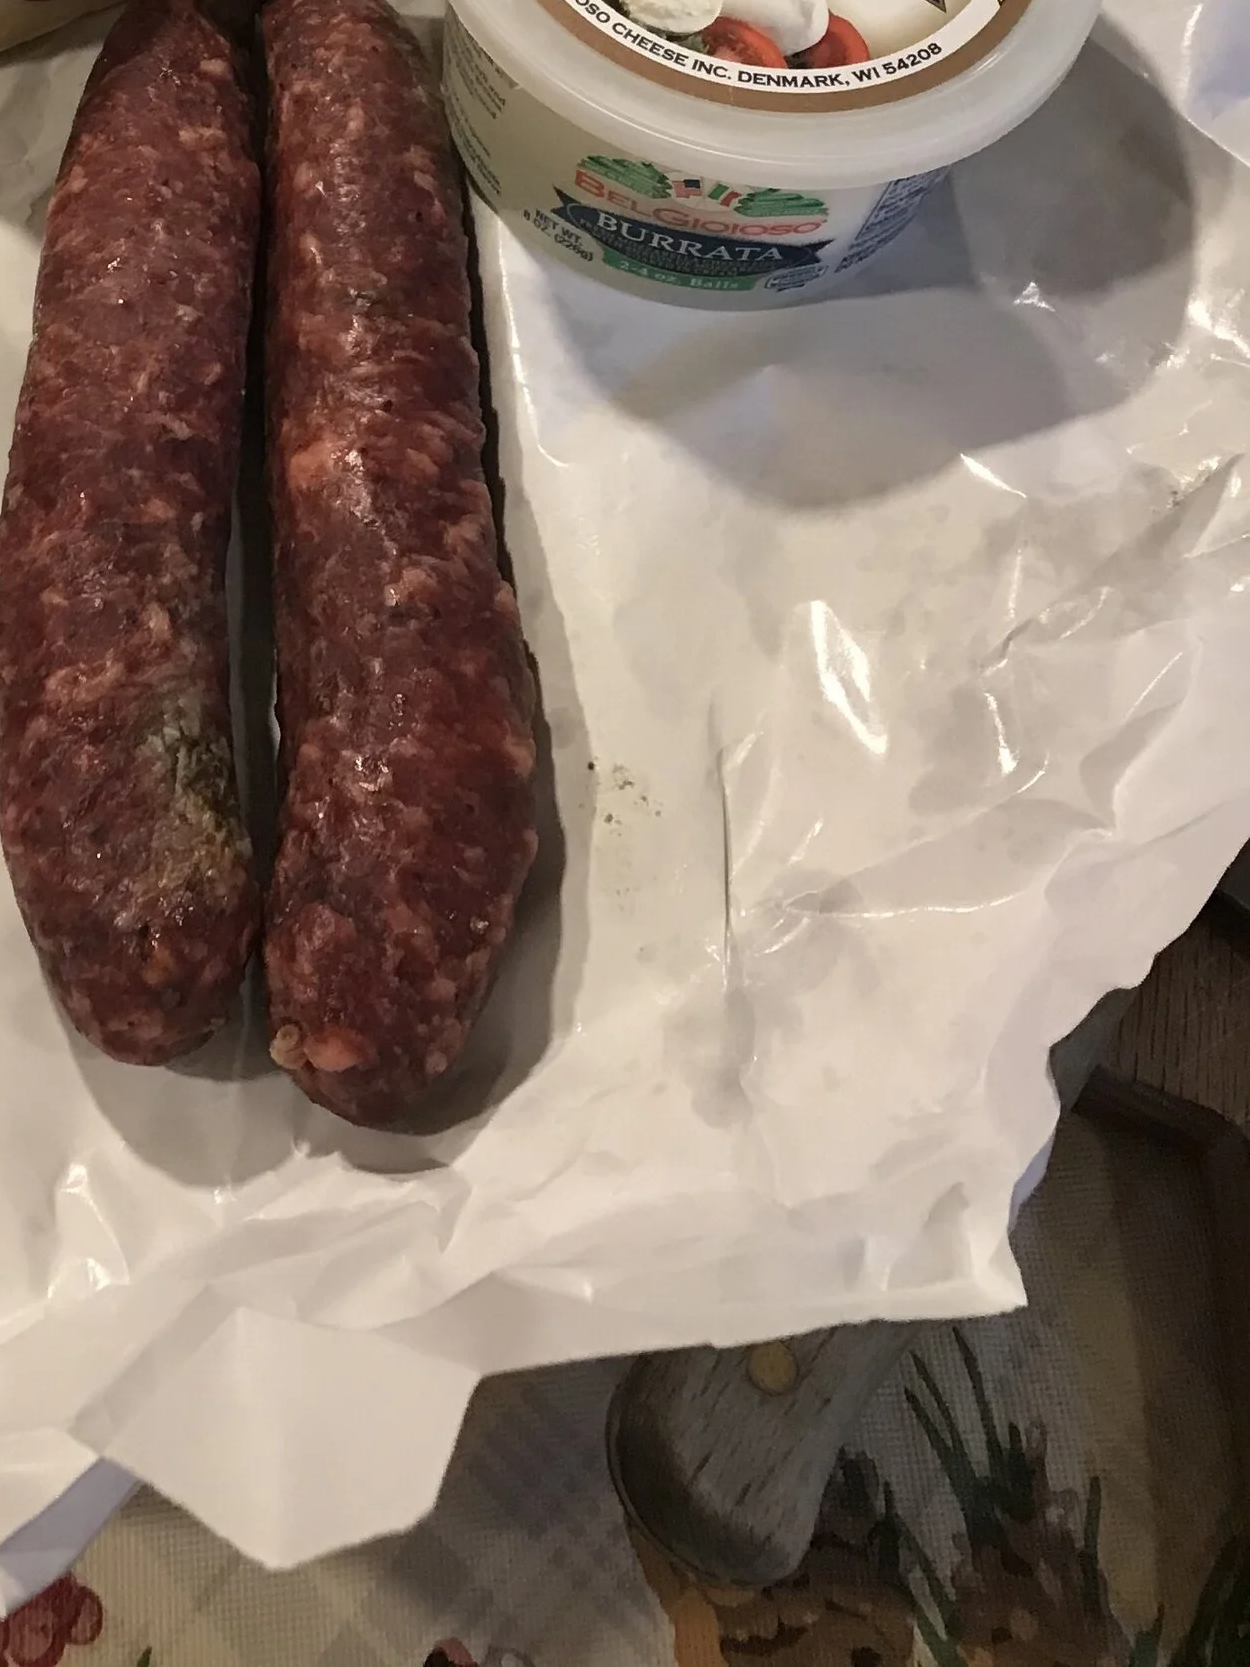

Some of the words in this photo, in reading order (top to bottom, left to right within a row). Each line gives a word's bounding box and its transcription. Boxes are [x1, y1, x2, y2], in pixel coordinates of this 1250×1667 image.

[611, 21, 690, 68] CHEESE
[690, 57, 733, 81] INC.
[737, 69, 851, 90] DENMARK,
[852, 65, 883, 86] WI
[885, 41, 944, 76] 54208
[596, 210, 783, 262] BURRATA
